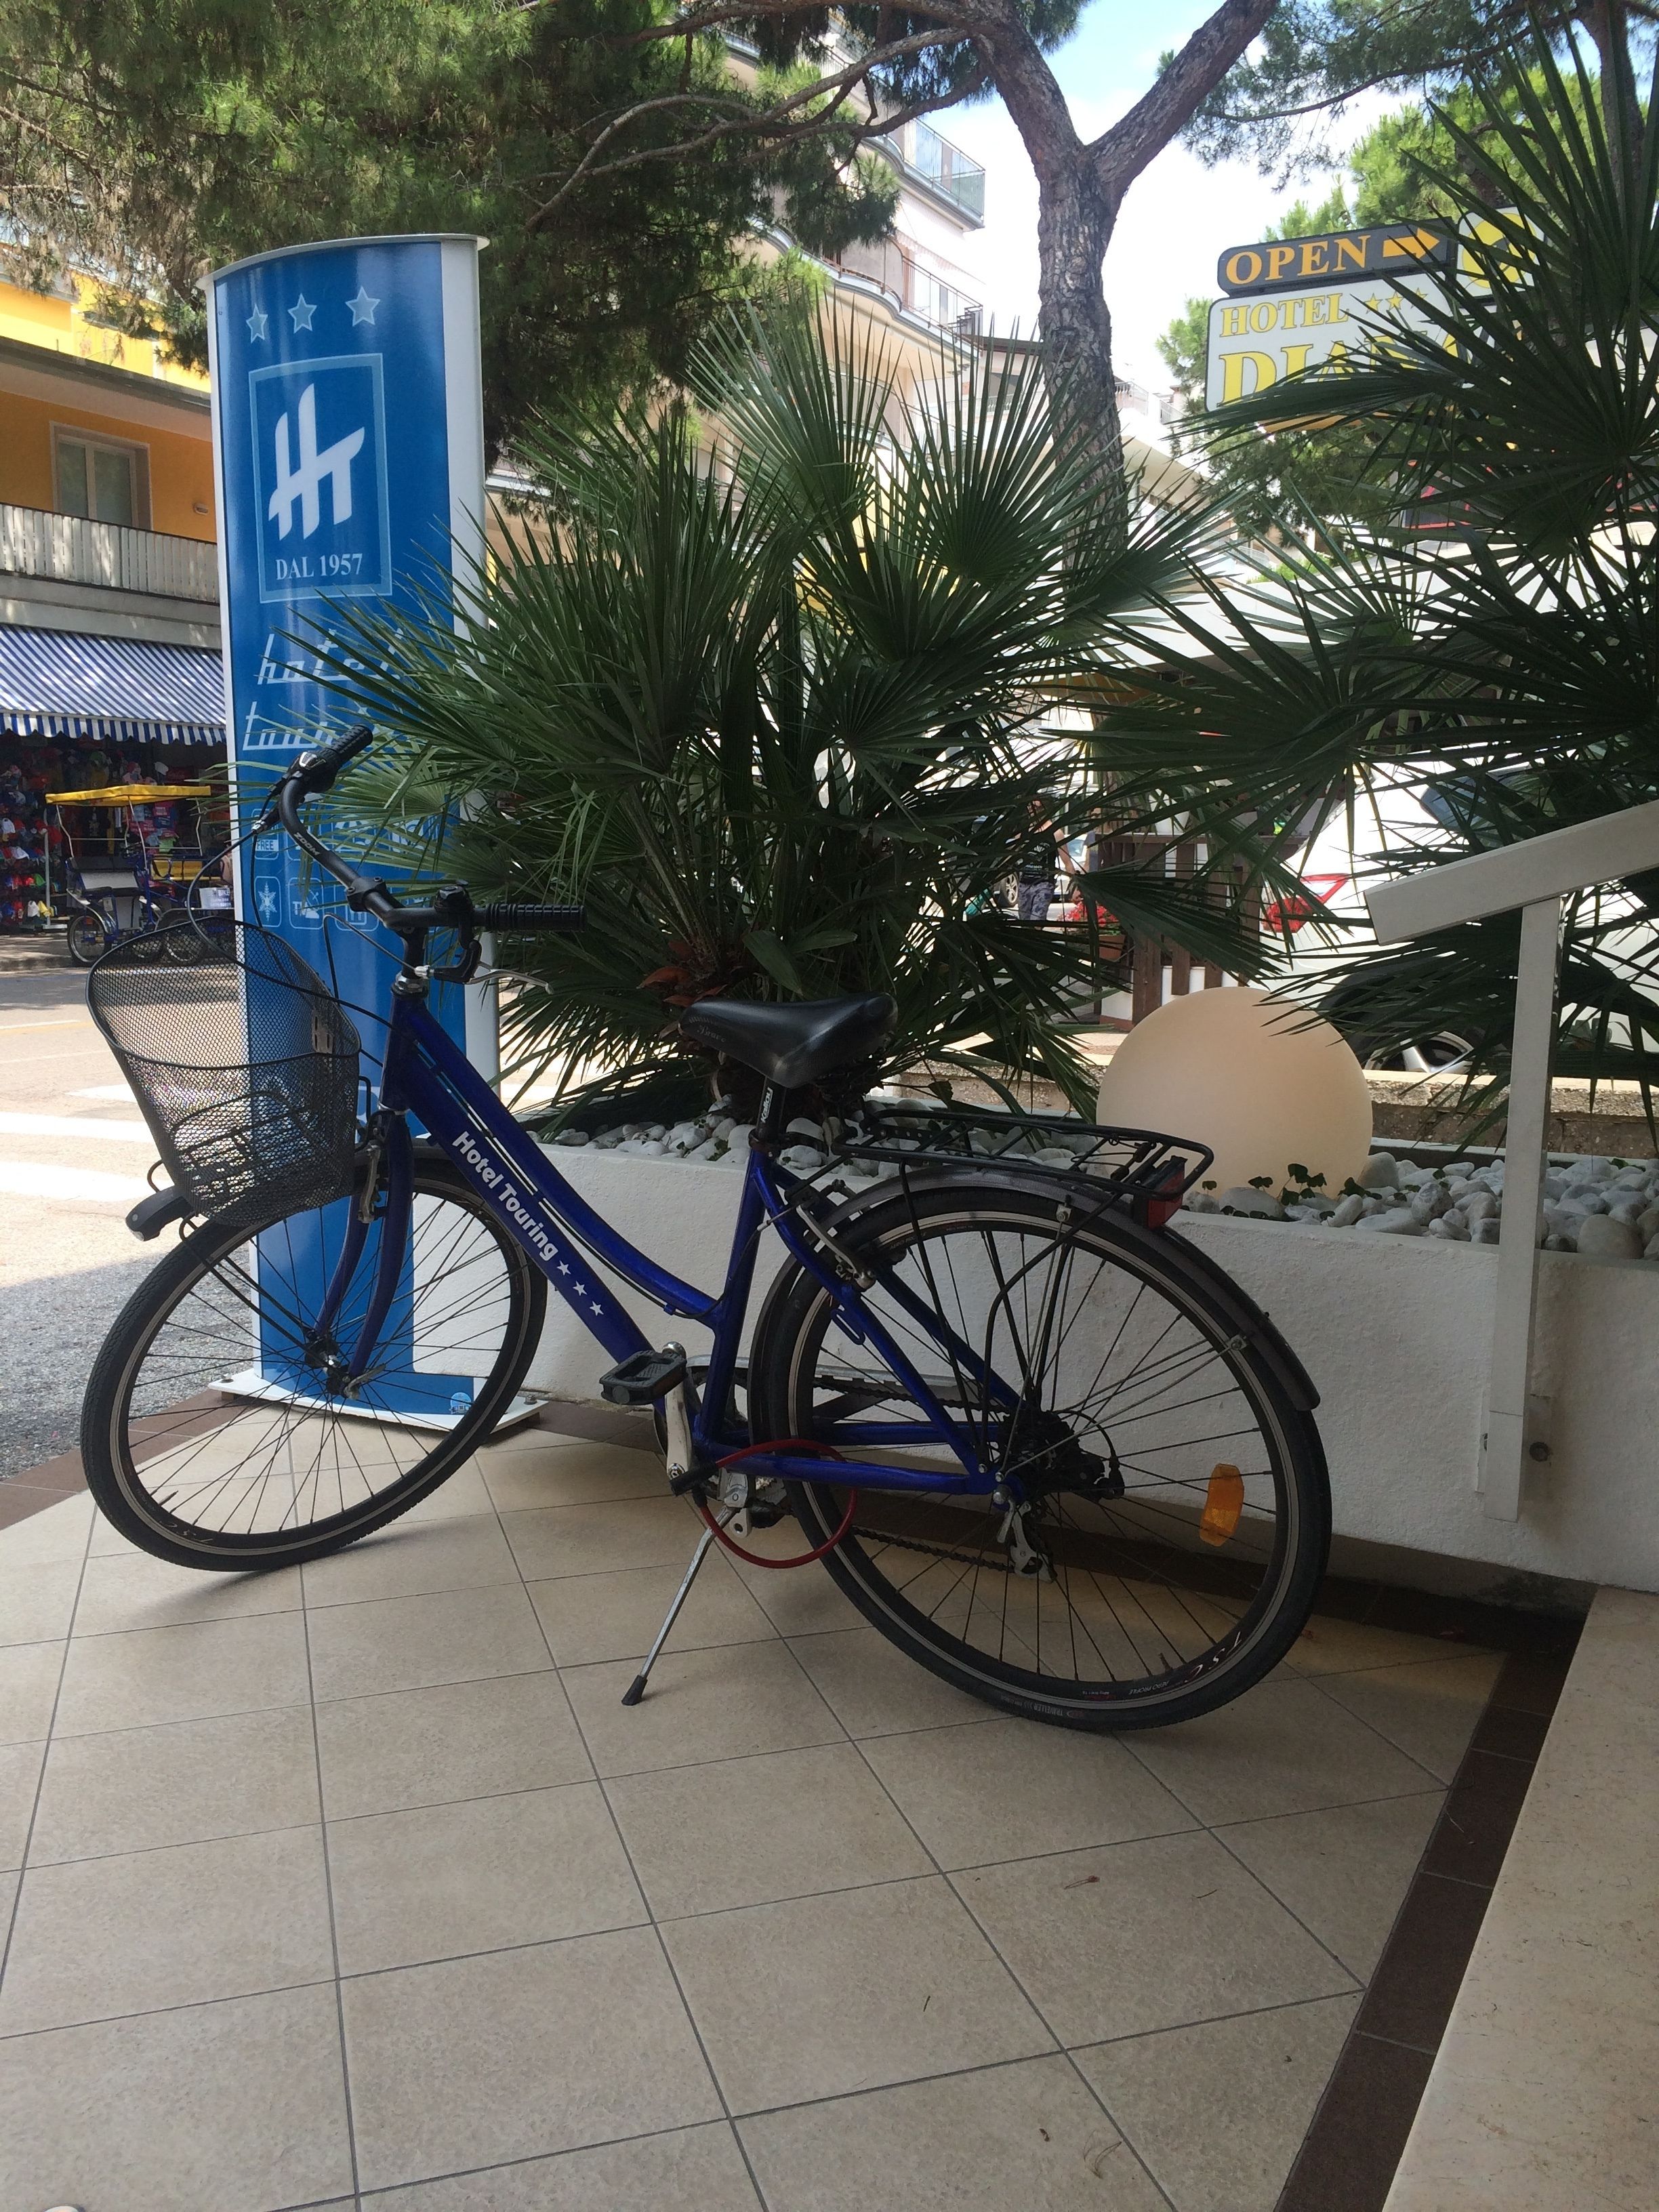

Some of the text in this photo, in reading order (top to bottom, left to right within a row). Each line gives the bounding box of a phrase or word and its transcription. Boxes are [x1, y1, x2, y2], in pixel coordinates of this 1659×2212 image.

[1225, 234, 1371, 285] OPEN
[1220, 293, 1350, 337] HOTEL
[275, 554, 363, 581] DAL 1957
[256, 840, 274, 851] FREE
[293, 832, 321, 856] ZOOM
[452, 1131, 504, 1189] Hotel
[498, 1183, 558, 1261] Touring
